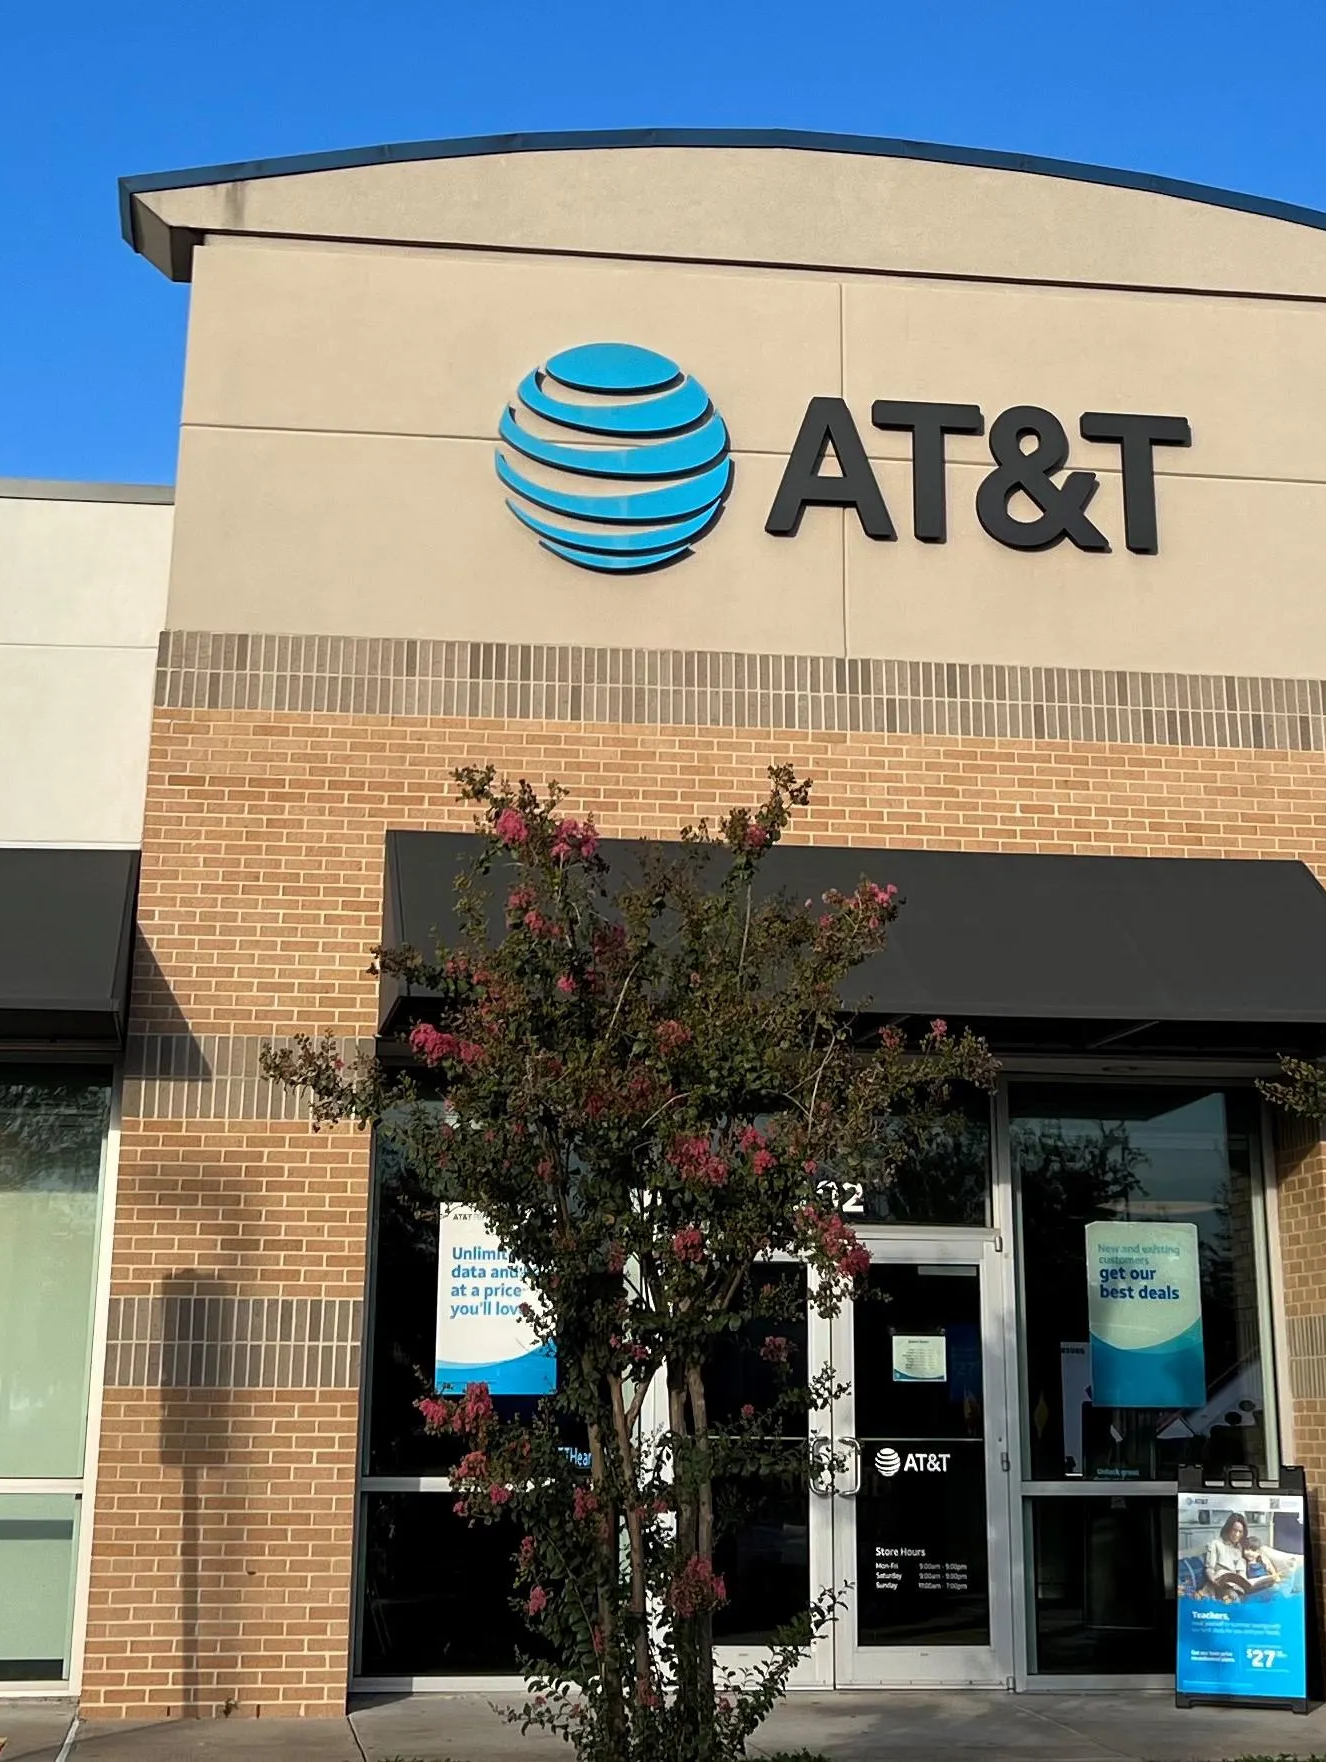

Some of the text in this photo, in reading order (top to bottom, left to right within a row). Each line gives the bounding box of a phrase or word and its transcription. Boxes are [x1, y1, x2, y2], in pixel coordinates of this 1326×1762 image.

[765, 397, 1192, 555] AT&T
[452, 1246, 508, 1260] Unlimit
[1098, 1243, 1180, 1256] New and existing
[1098, 1256, 1149, 1265] customers
[451, 1265, 487, 1278] data
[1099, 1267, 1156, 1282] get our
[451, 1283, 522, 1299] at a price
[1100, 1285, 1179, 1299] best deals
[450, 1301, 520, 1319] you'll lov
[903, 1453, 951, 1472] AT&T
[875, 1546, 926, 1556] Store Hours
[875, 1582, 898, 1590] Sunday
